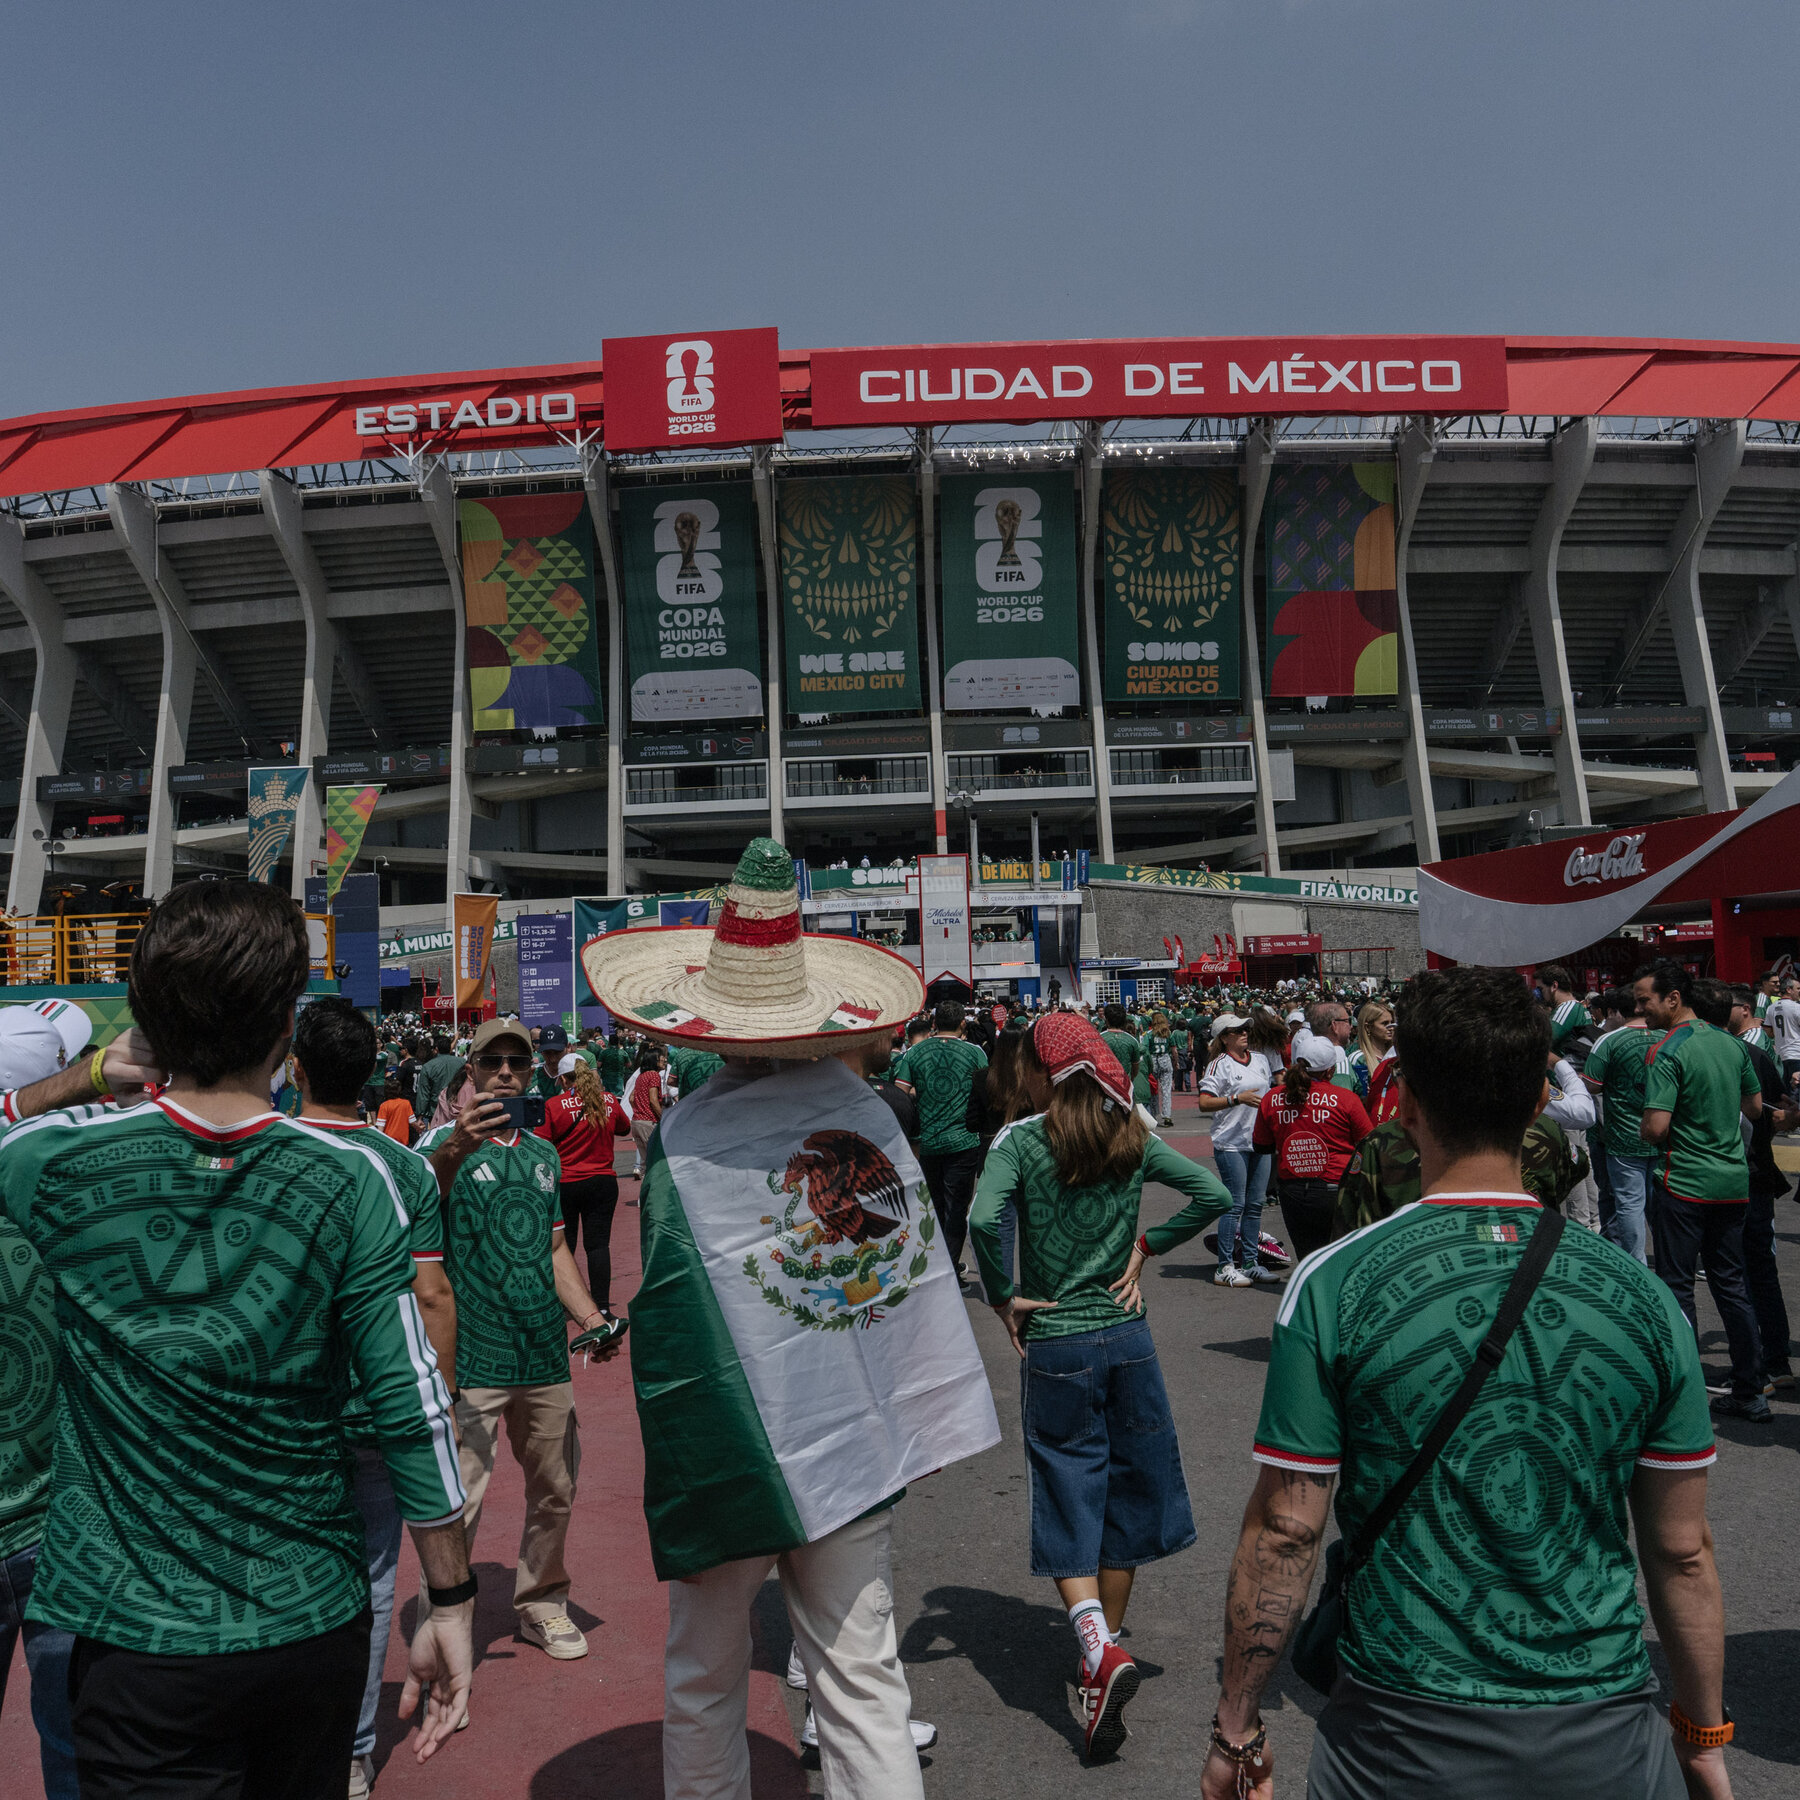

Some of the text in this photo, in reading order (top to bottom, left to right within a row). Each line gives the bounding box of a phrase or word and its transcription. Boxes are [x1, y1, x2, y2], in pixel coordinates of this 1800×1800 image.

[859, 353, 1461, 403] CIUDAD DE MÉXICO
[681, 397, 702, 407] FIFA
[356, 392, 576, 436] ESTADIO
[668, 415, 696, 423] WORLD
[668, 422, 716, 435] 2026
[995, 571, 1025, 582] FIFA
[676, 583, 706, 595] FIFA
[977, 595, 1044, 606] WORLD CUP
[658, 607, 725, 628] COPA
[976, 607, 1044, 623] 2026
[658, 628, 726, 642] MUNDIAL
[660, 641, 727, 659] 2026
[1127, 641, 1220, 661] SOMOS
[799, 651, 906, 674] WE ARE
[1126, 664, 1220, 679] CIUDAD DE
[800, 673, 906, 692] MEXICO CITY
[1126, 678, 1219, 694] MÉXICO
[1563, 832, 1647, 887] Coca-Cola
[982, 863, 998, 880] DE
[1000, 862, 1051, 880] MÉXIO
[1300, 881, 1406, 903] FIFA WORLD
[824, 901, 847, 909] CERVEZA
[926, 908, 964, 919] Michelob
[380, 942, 402, 957] PA
[404, 932, 454, 953] MUND
[460, 925, 470, 979] SOMOS
[1249, 943, 1254, 953] 1
[469, 926, 478, 979] CIUDAD DE
[1201, 961, 1229, 972] Coca-Cola
[1775, 1014, 1785, 1037] 9
[561, 1094, 615, 1110] RECAS
[1271, 1092, 1338, 1107] RECRGAS
[1276, 1109, 1299, 1124] TOP
[1312, 1109, 1331, 1124] UP
[1288, 1144, 1322, 1152] CASHLESS
[1290, 1138, 1317, 1146] EVENTO
[1286, 1152, 1316, 1160] SOLÍCITA
